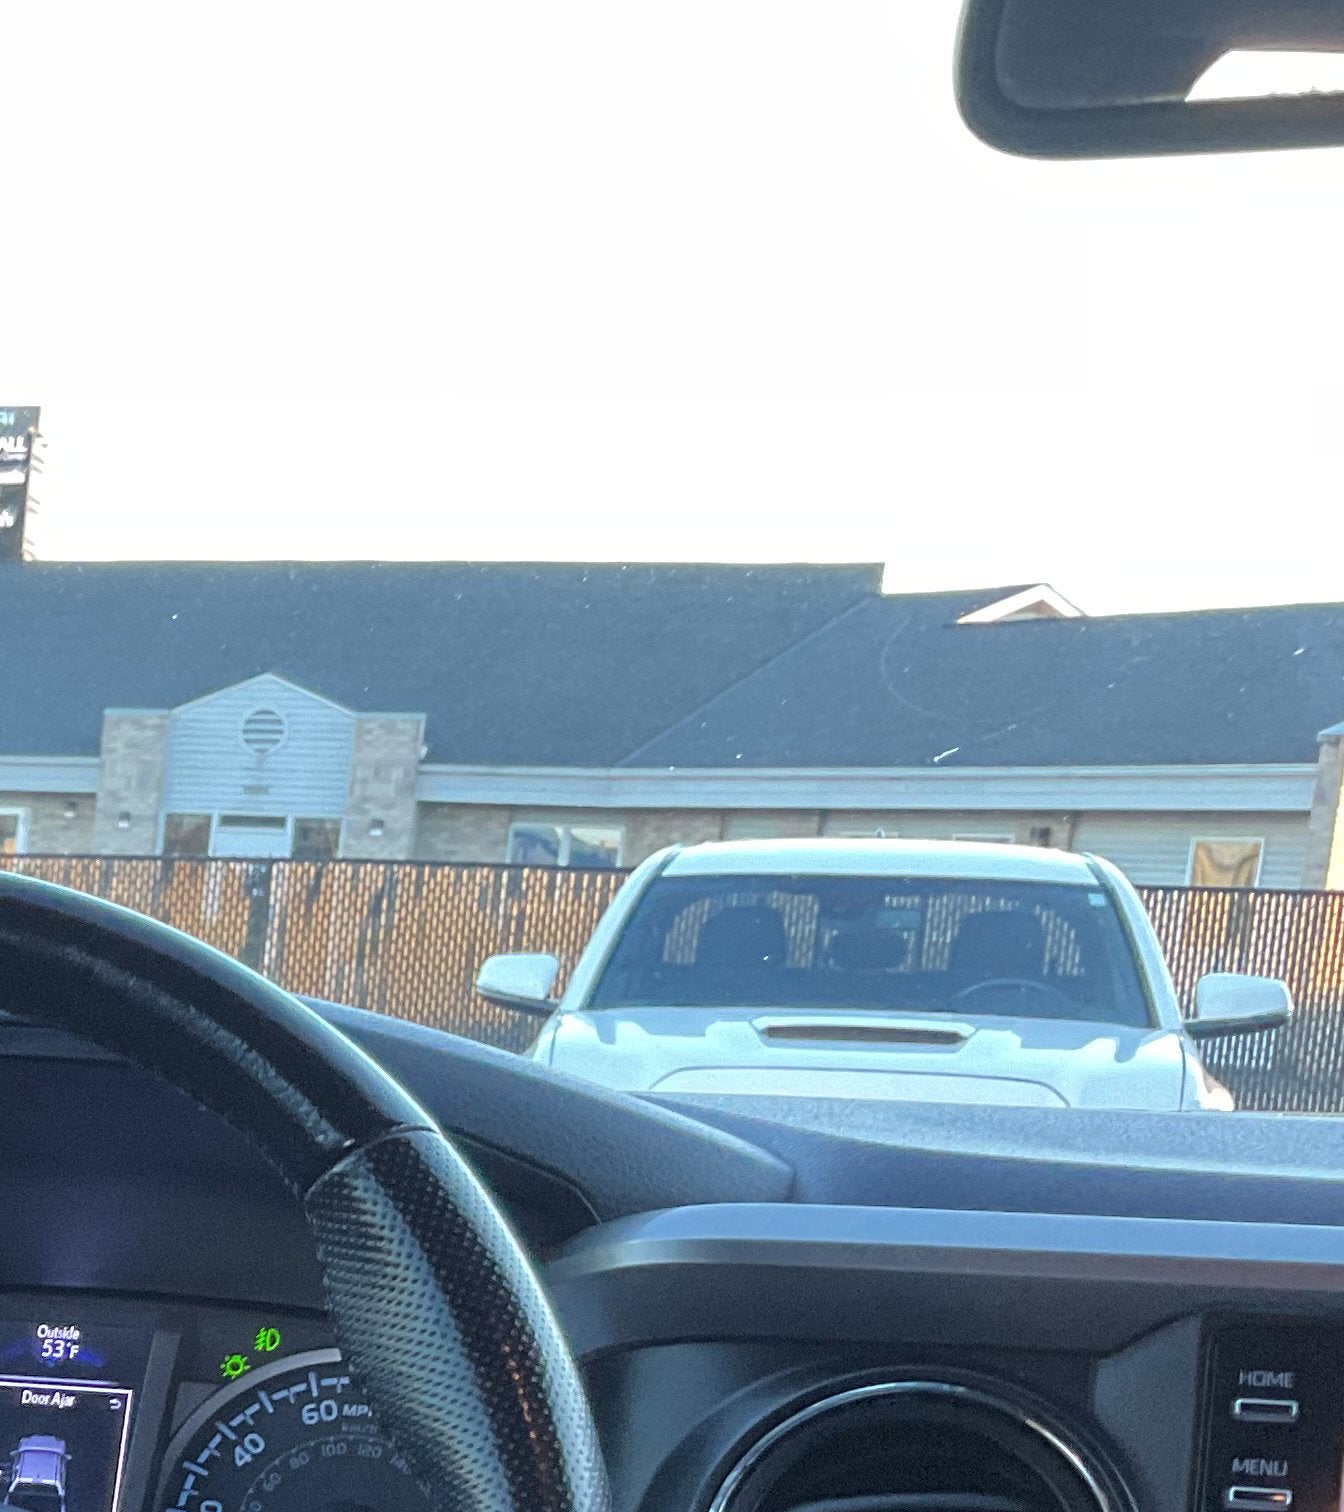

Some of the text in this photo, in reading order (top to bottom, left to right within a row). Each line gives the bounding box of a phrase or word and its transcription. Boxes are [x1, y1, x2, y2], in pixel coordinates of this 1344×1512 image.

[36, 1323, 80, 1341] Outside
[1238, 1368, 1295, 1389] HOME
[21, 1389, 77, 1409] Door Ajar
[233, 1432, 266, 1467] 40
[301, 1399, 338, 1425] 60
[1231, 1457, 1289, 1477] MENU
